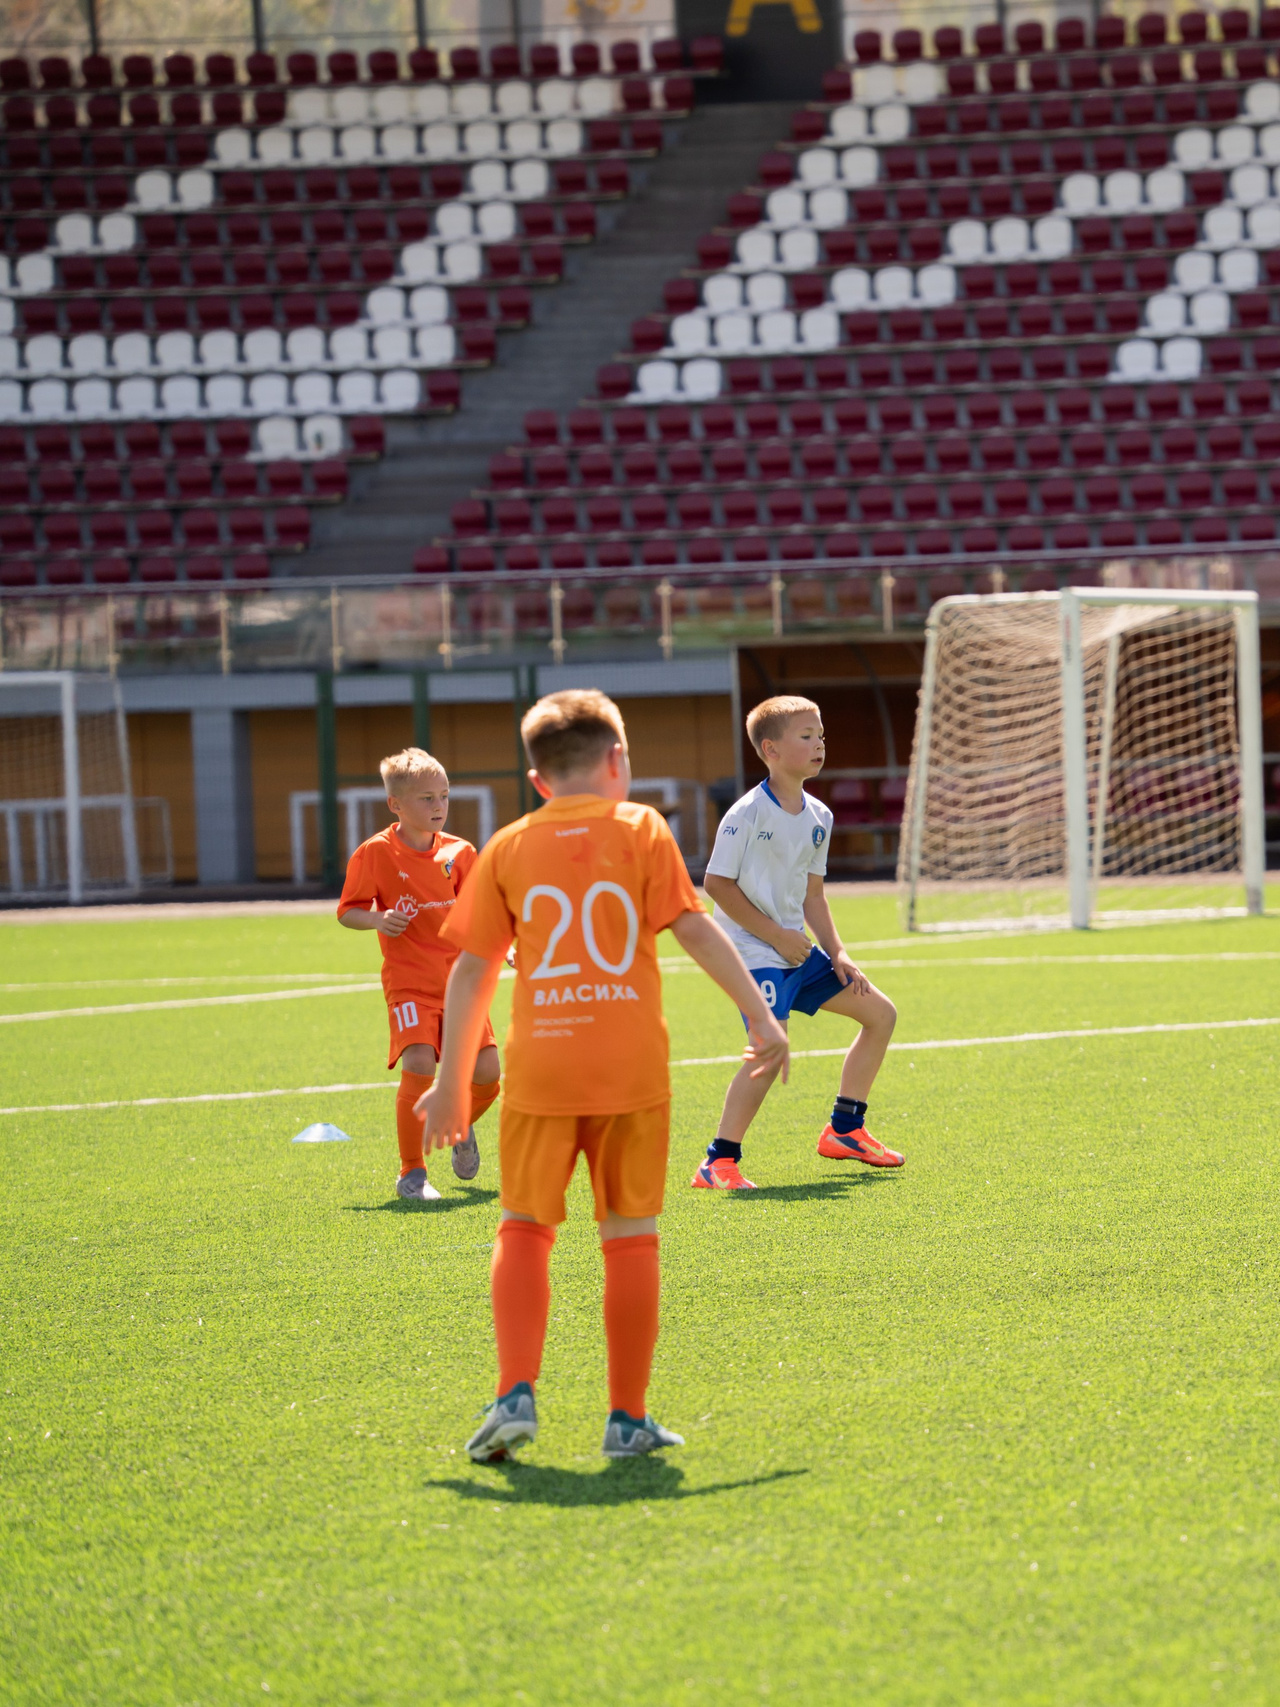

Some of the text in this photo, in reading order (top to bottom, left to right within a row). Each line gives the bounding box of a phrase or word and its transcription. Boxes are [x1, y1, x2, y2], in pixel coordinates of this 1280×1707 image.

[757, 831, 774, 841] FN
[522, 880, 640, 980] 20
[533, 983, 641, 1007] ВЛАСИХА
[760, 979, 778, 1008] 9
[393, 1001, 420, 1033] 10
